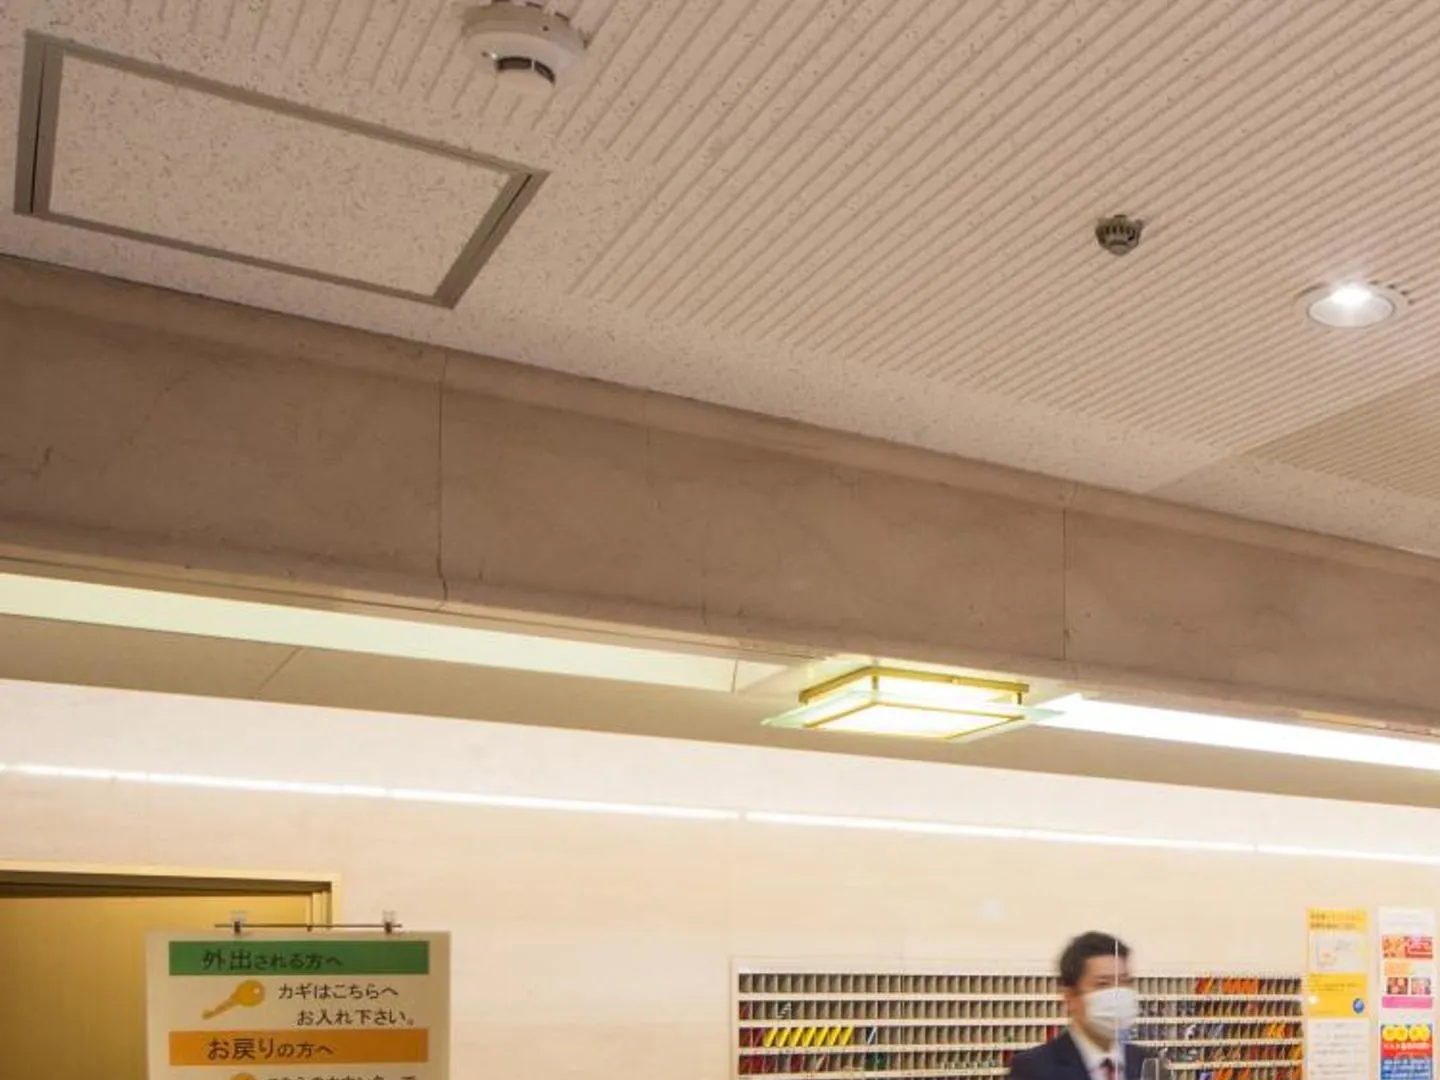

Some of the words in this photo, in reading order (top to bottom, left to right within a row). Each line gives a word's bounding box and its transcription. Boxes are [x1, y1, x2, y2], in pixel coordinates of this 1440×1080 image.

[201, 948, 344, 971] 外出される方へ
[278, 983, 399, 1000] カギはこちらへ
[296, 1008, 415, 1027] お入れ下さい。
[207, 1037, 334, 1061] お戻りの方へ
